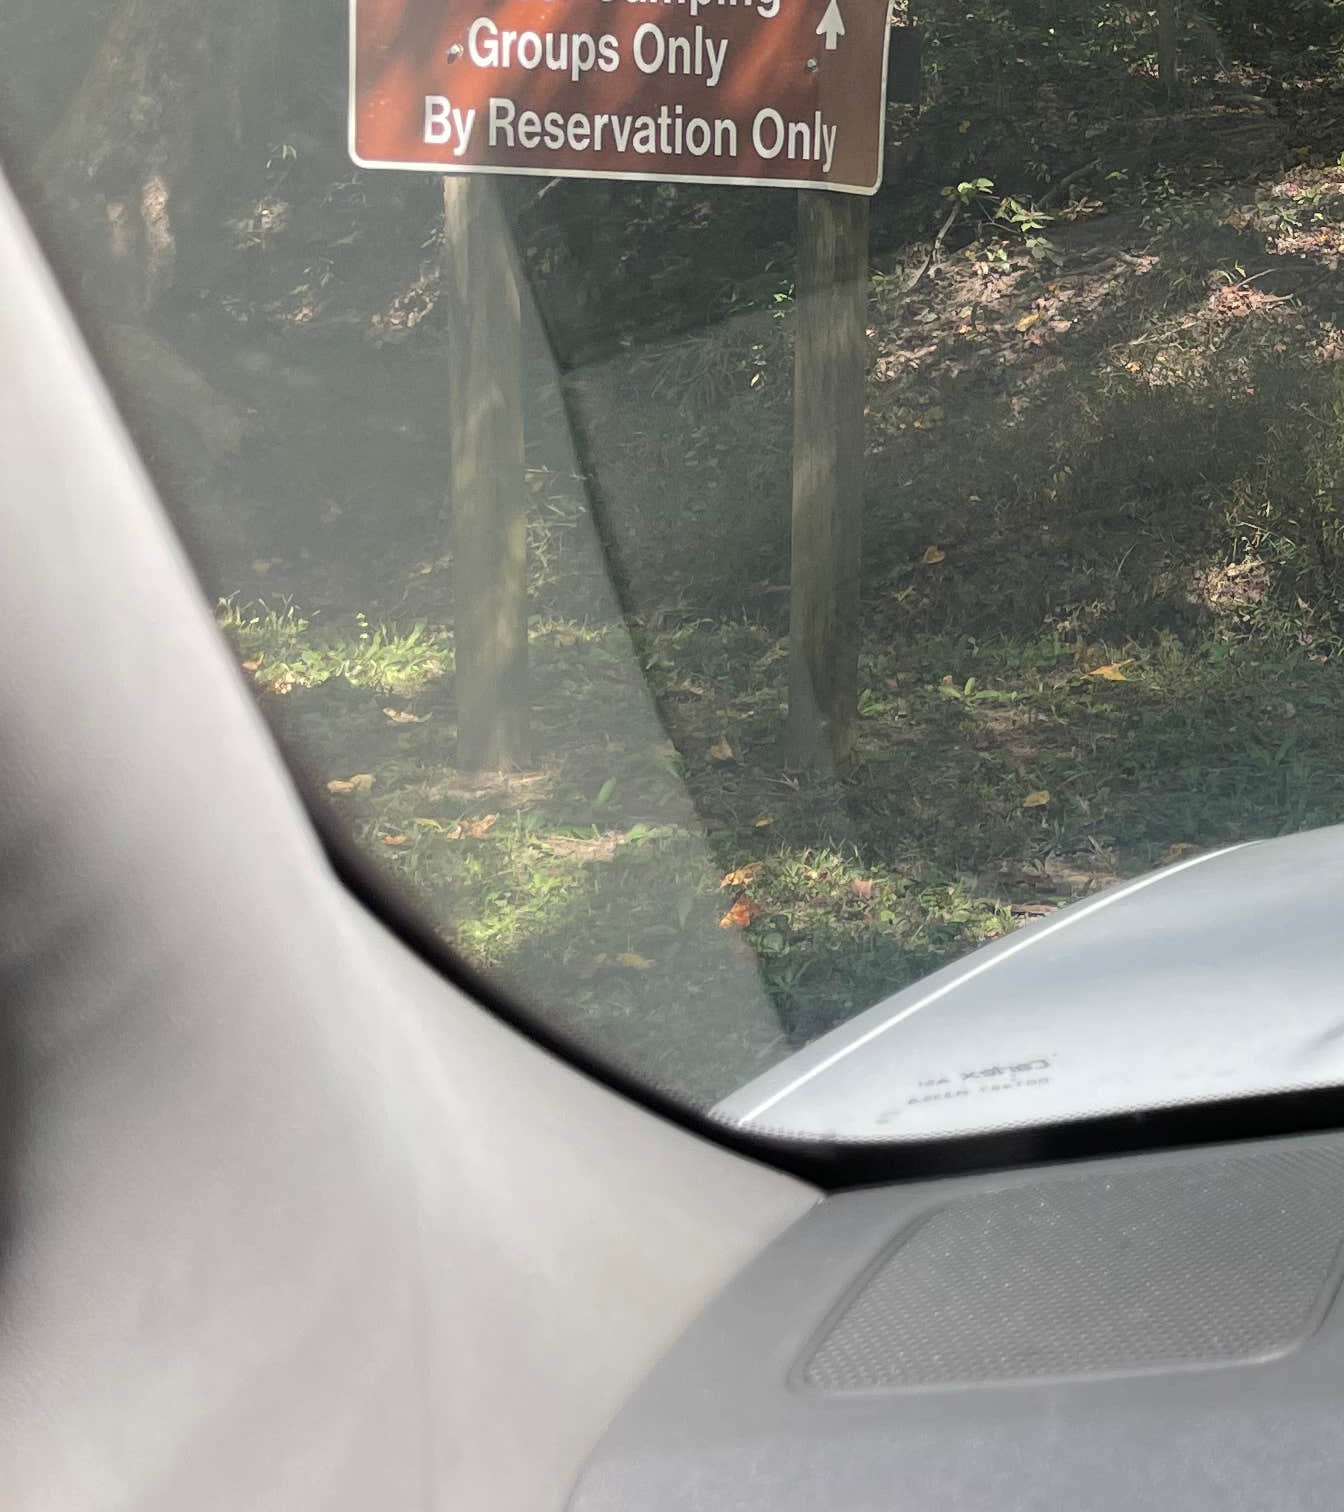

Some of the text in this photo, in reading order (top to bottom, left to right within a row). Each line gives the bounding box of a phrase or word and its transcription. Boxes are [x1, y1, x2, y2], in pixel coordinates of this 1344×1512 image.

[468, 17, 729, 87] Groups Only
[423, 95, 837, 173] By Reservation Only
